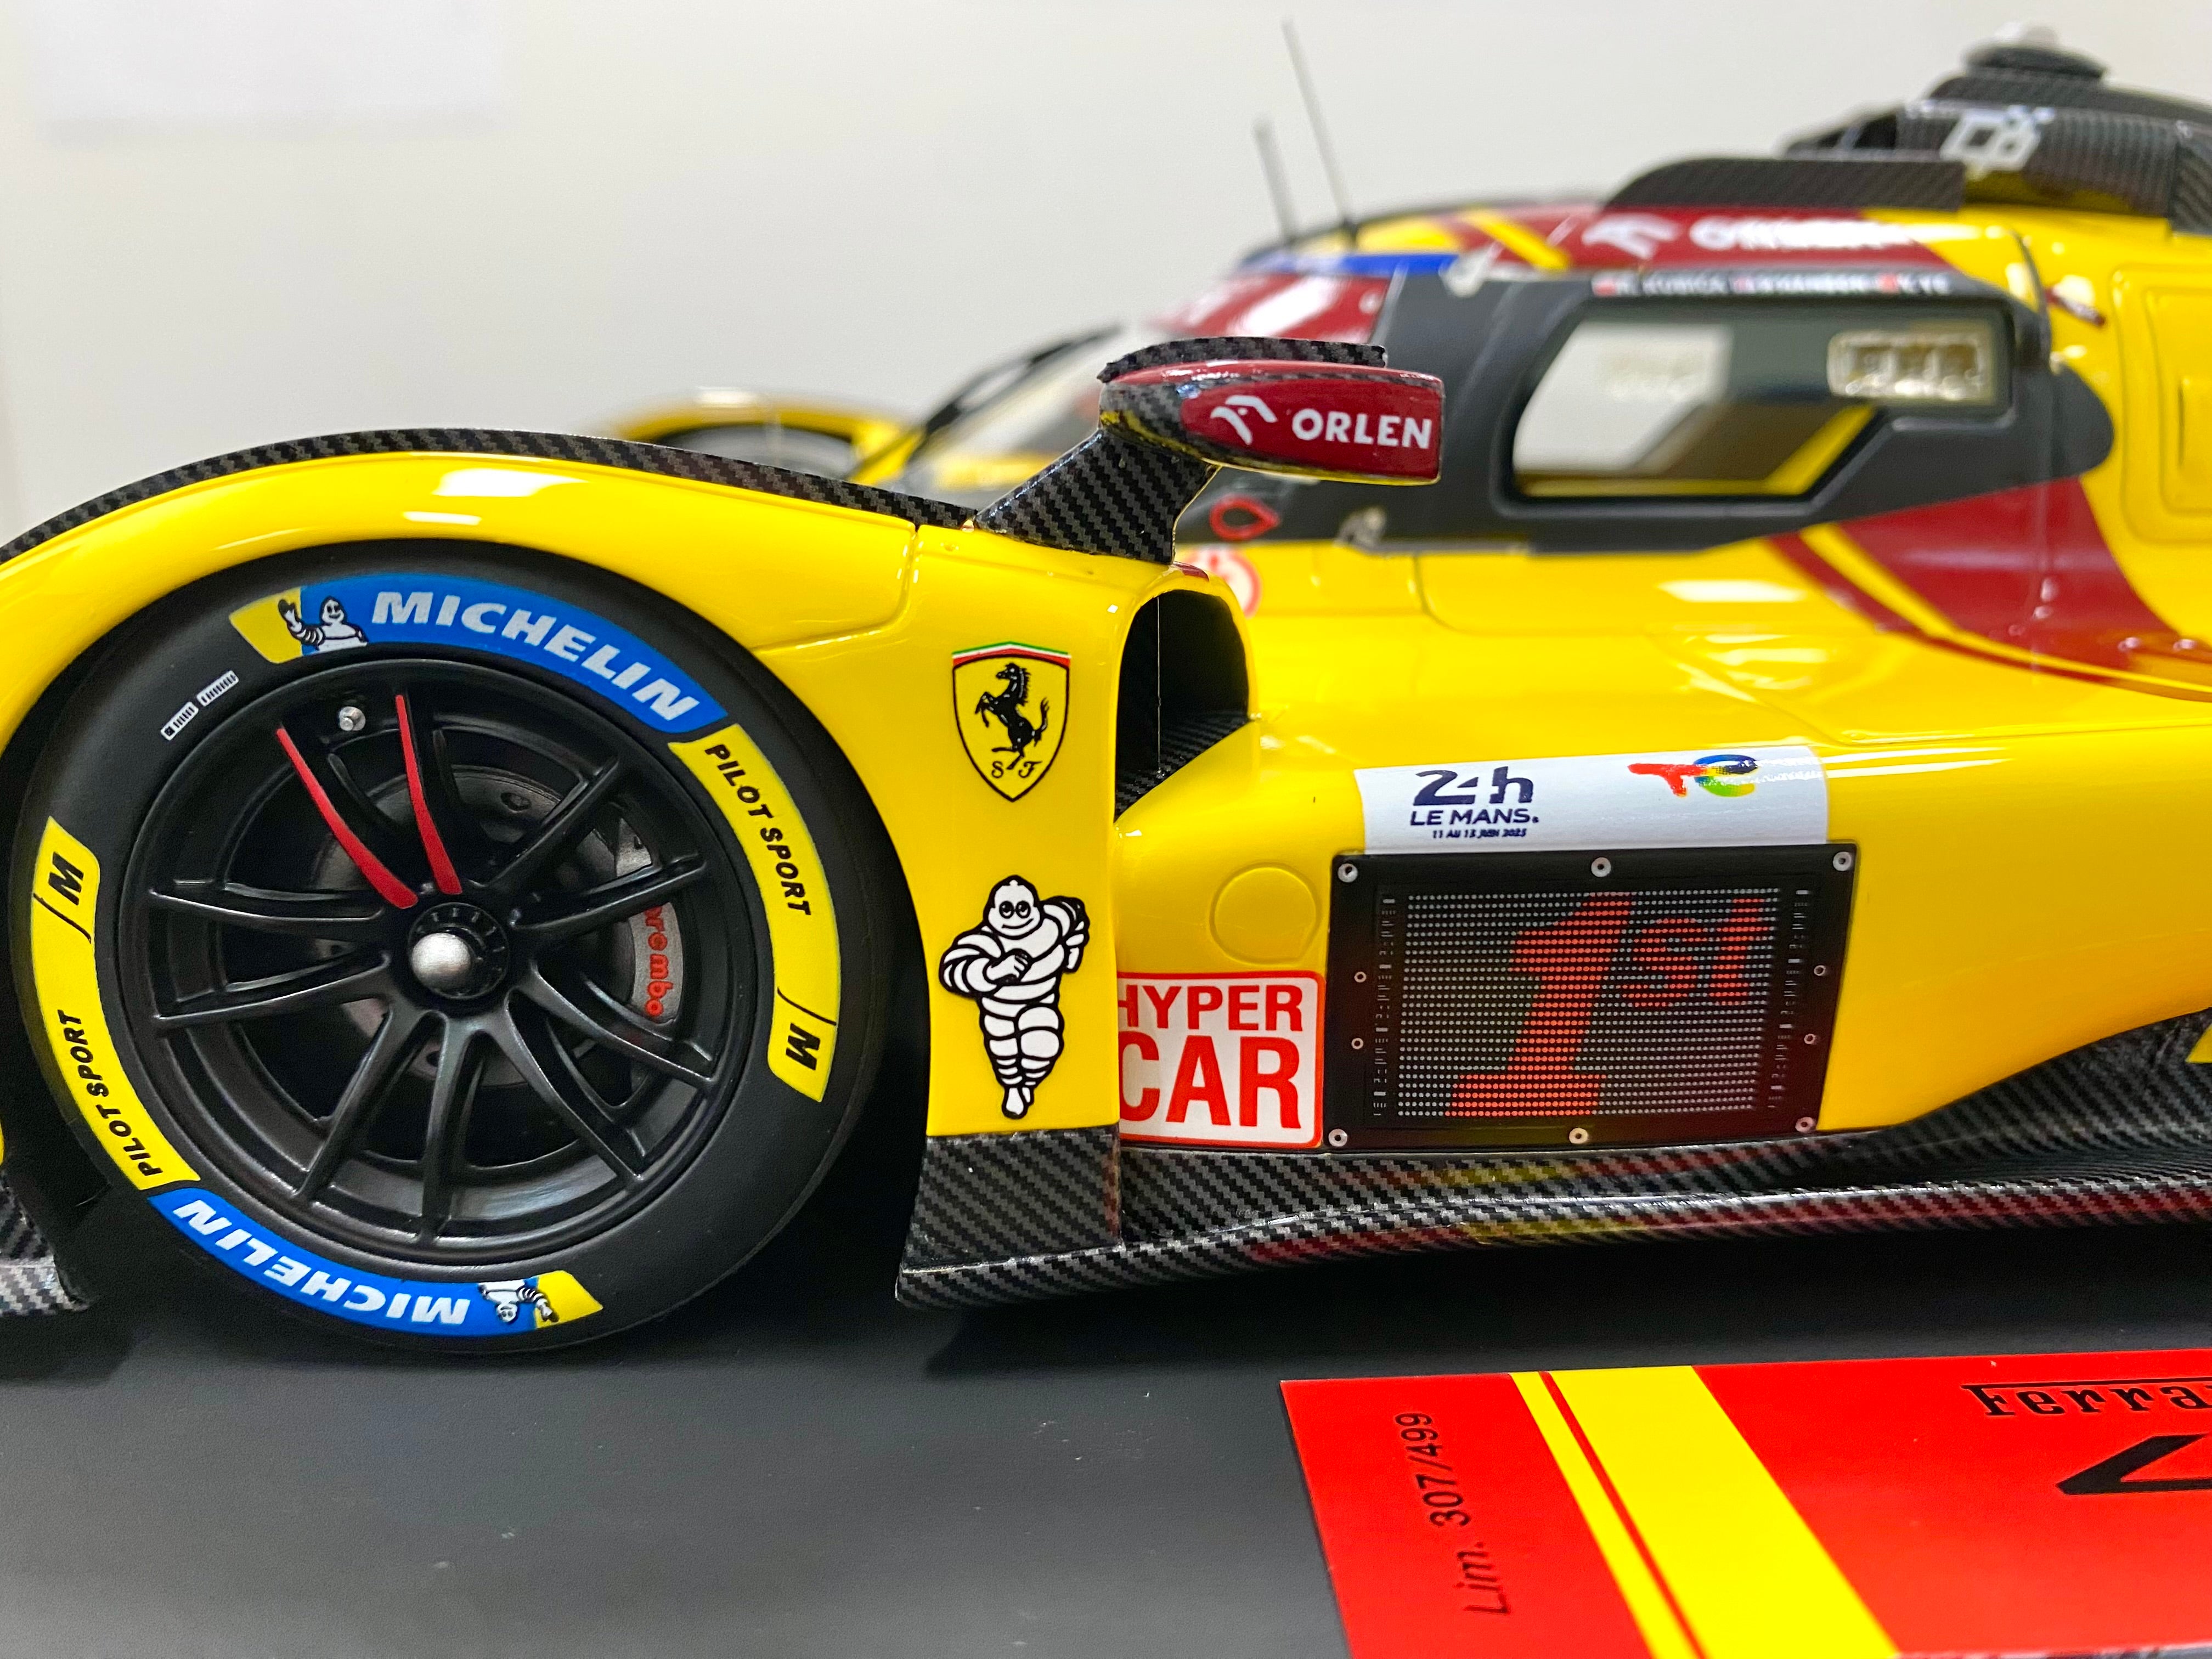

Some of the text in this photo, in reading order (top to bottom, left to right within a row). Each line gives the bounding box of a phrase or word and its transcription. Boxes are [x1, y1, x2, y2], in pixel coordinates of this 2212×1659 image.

[1291, 408, 1432, 449] ORLEN
[371, 591, 699, 721] MICHELIN
[705, 743, 811, 916] PILOT SPORT
[1410, 810, 1443, 826] LE
[1118, 984, 1303, 1032] HYPER
[58, 1009, 163, 1177] PILOT SPORT
[1118, 1031, 1302, 1129] CAR
[174, 1199, 471, 1324] MICHELIN
[1960, 1376, 2212, 1416] Ferra
[1395, 1412, 1510, 1615] Lim. 307/499
